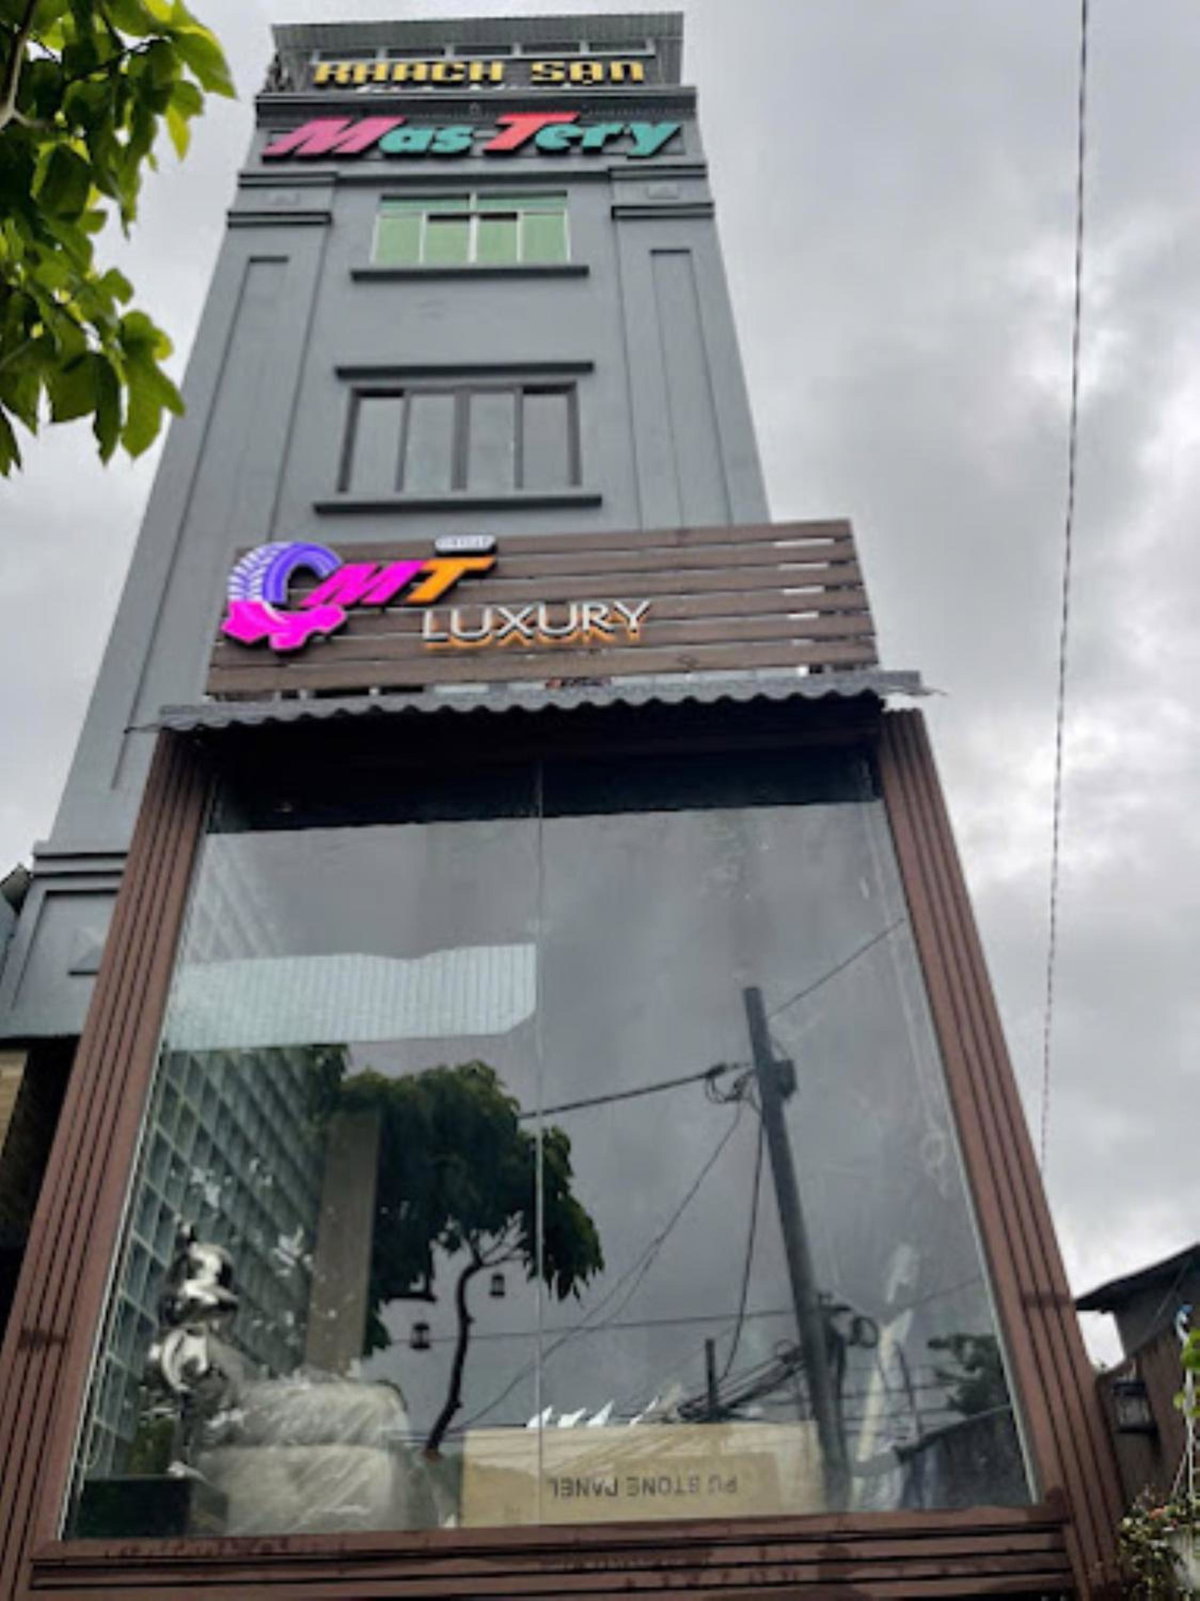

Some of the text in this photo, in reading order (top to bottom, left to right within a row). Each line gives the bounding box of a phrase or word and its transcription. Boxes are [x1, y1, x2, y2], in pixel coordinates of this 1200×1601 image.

[422, 600, 650, 643] LUXURY
[548, 1476, 620, 1499] PANEL
[624, 1475, 700, 1498] STONE
